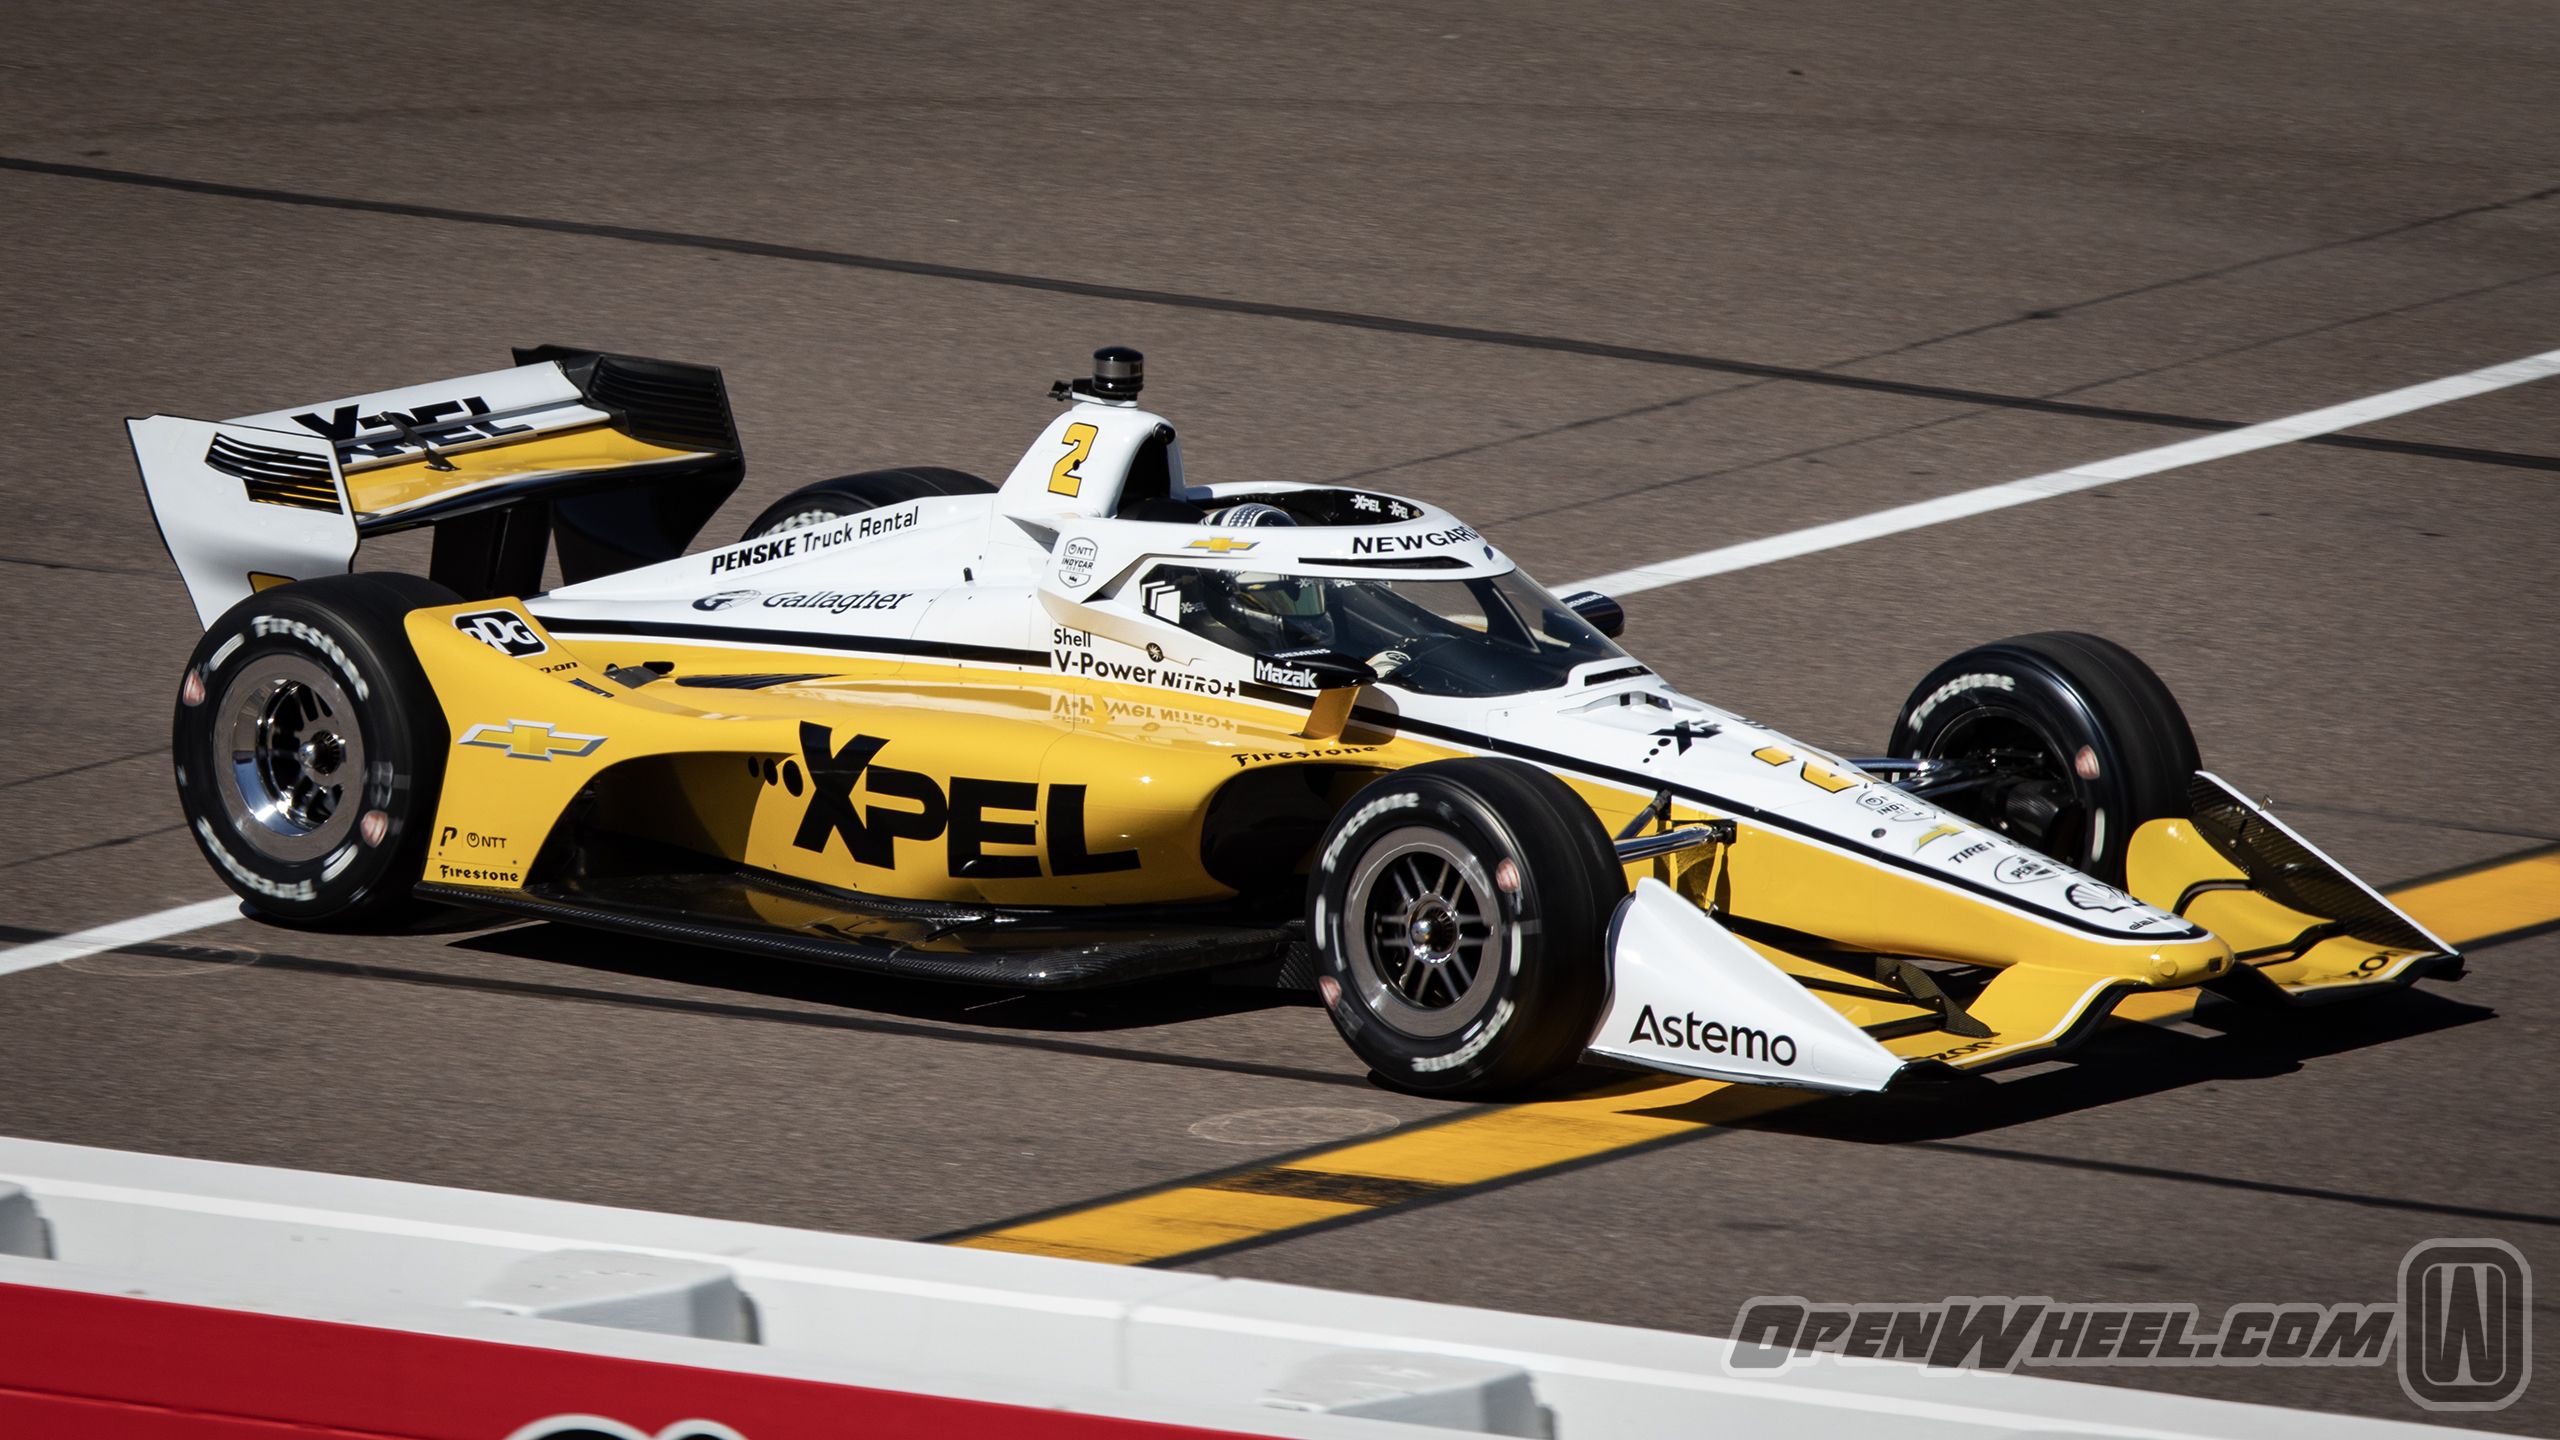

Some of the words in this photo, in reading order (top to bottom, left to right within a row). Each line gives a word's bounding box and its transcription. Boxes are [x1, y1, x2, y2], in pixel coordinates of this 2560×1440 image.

[1048, 422, 1098, 498] 2
[1353, 494, 1381, 513] XPEL
[711, 537, 796, 575] PENSKE
[803, 523, 853, 552] Truck
[859, 506, 919, 538] Rental
[1061, 557, 1094, 569] INDYCAR
[763, 590, 914, 615] Gallagher
[1053, 628, 1091, 647] Shell
[1054, 650, 1157, 684] V-Power
[1256, 659, 1318, 688] Mazak
[1231, 746, 1378, 767] Firestone
[792, 720, 1141, 878] XPEL
[481, 836, 507, 849] NTT
[439, 864, 519, 882] Firestone
[1629, 1004, 1797, 1067] Astemo
